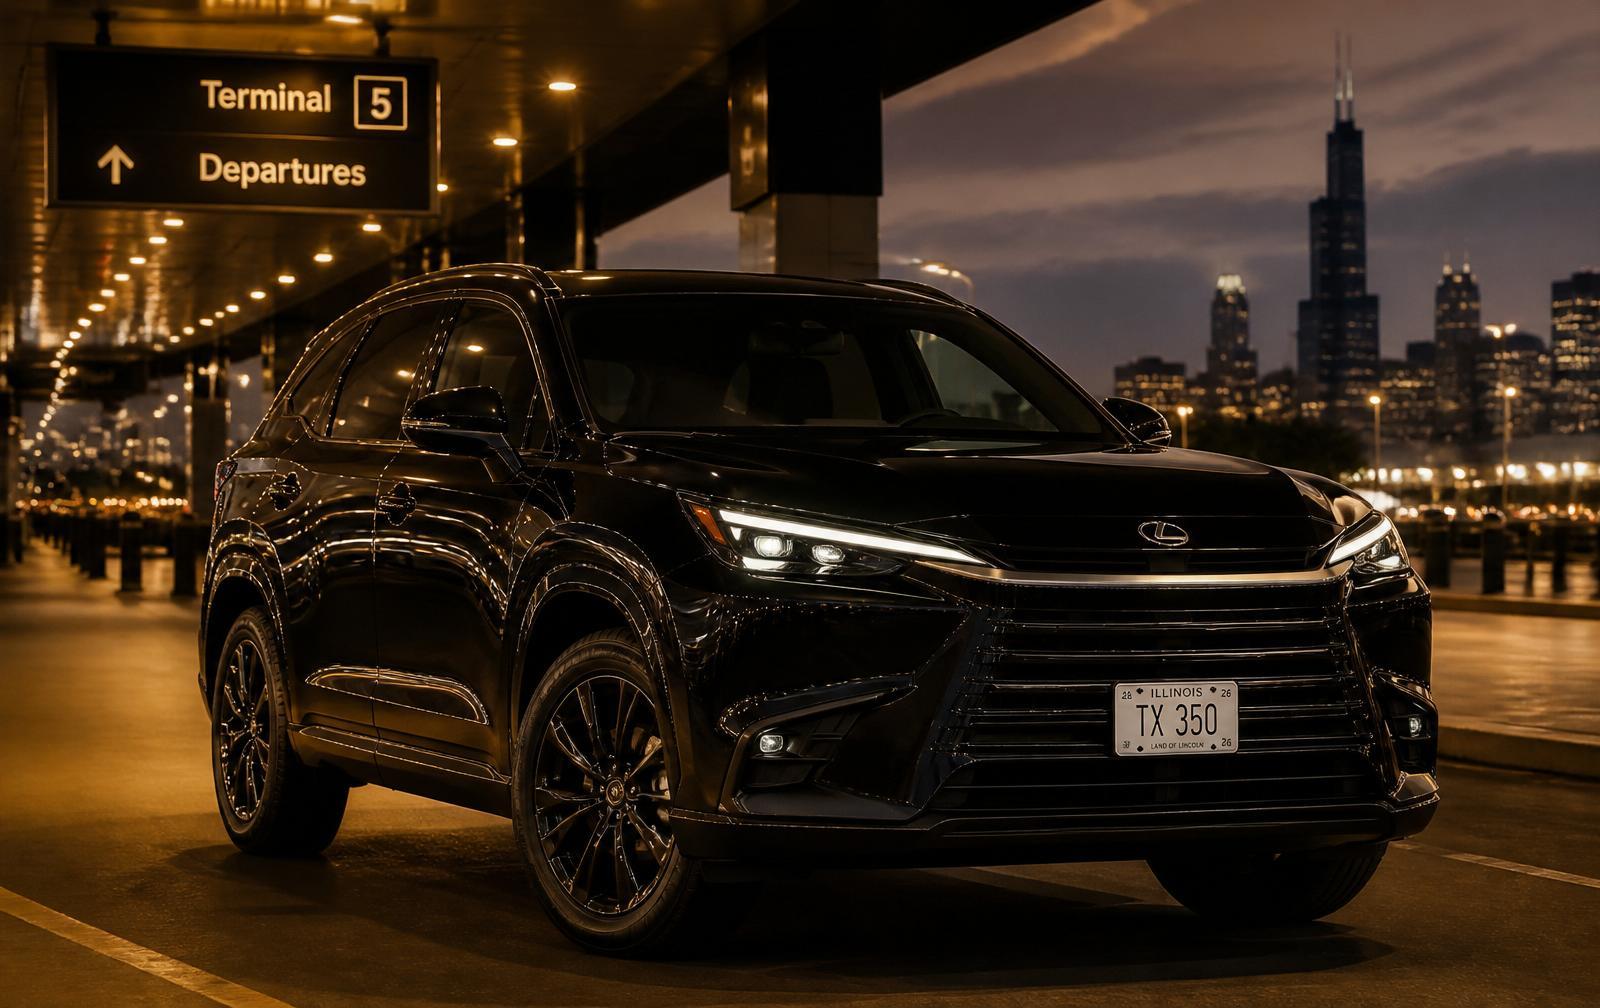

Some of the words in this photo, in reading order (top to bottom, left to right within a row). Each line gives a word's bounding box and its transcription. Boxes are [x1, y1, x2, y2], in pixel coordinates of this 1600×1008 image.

[200, 79, 332, 114] Terminal
[370, 87, 393, 121] 5
[199, 152, 367, 190] Departures
[1151, 687, 1203, 698] ILLINOIS
[1221, 688, 1232, 698] 26
[1136, 704, 1164, 737] TX
[1175, 703, 1217, 736] 350
[1221, 738, 1232, 747] 26
